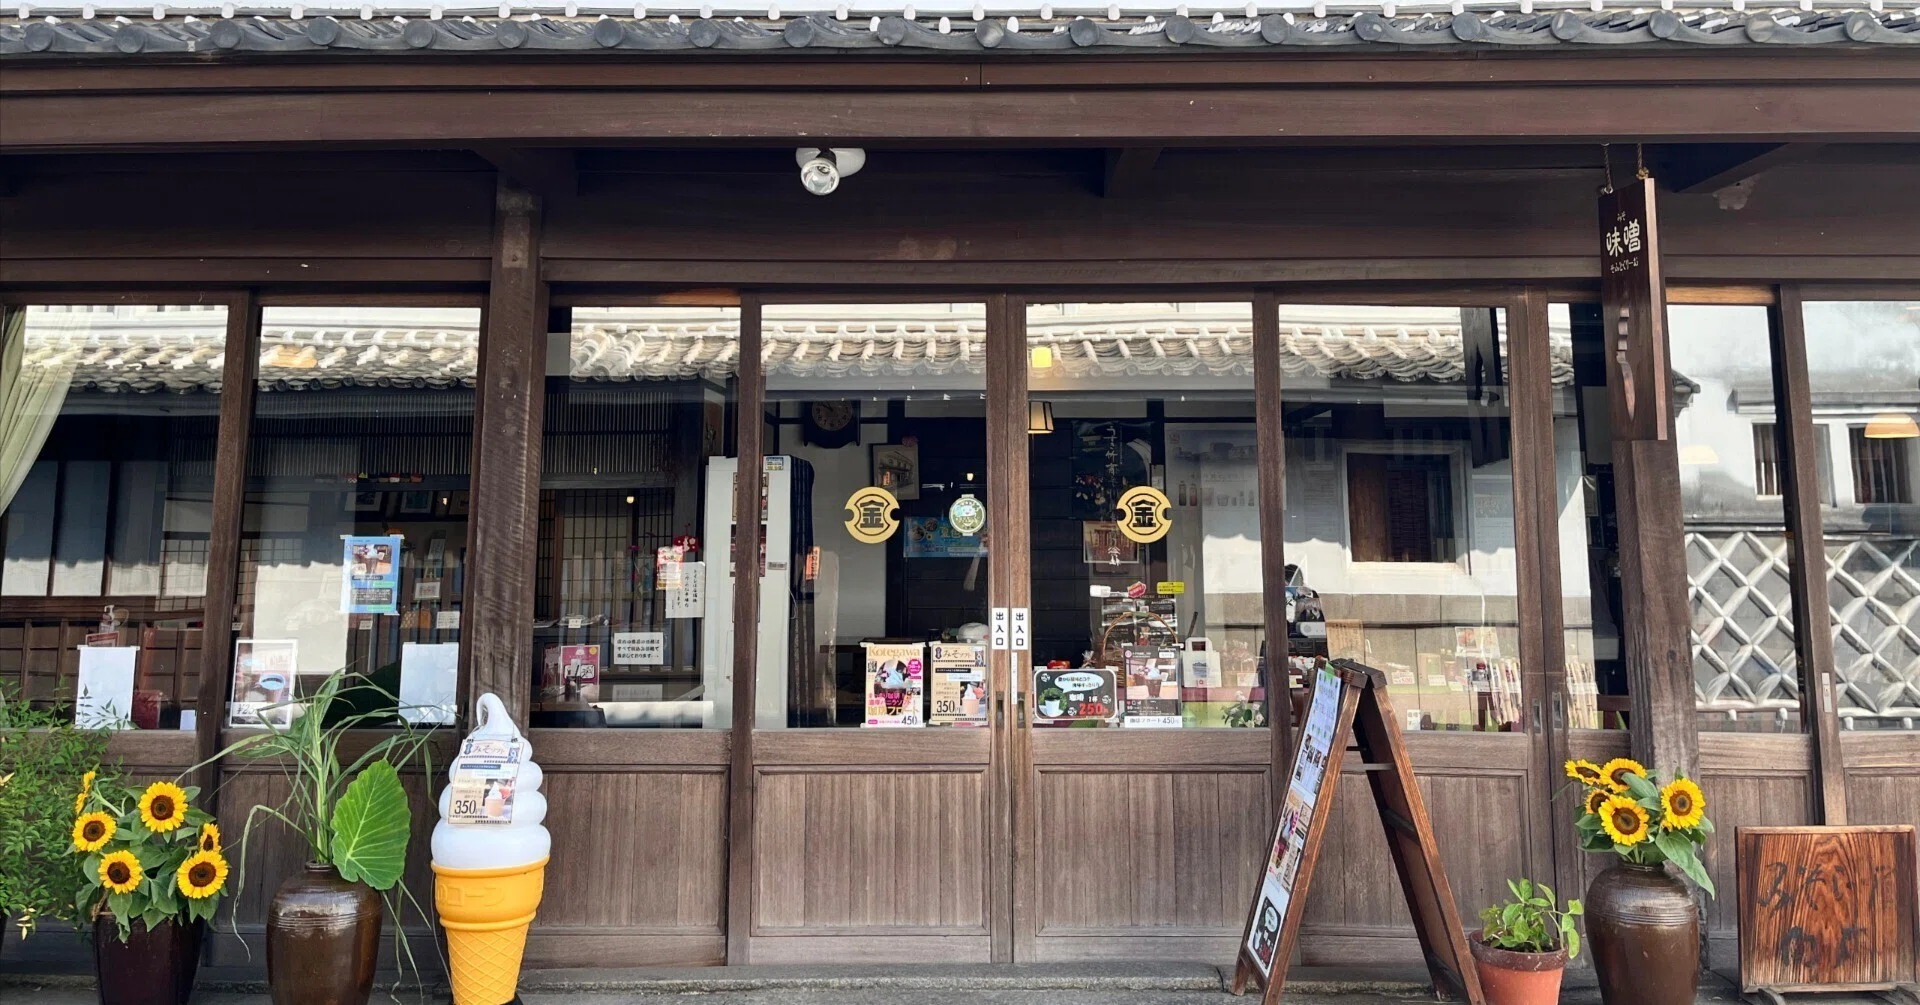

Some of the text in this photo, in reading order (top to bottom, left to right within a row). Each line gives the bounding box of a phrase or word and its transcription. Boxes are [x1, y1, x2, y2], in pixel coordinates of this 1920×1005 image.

[1606, 218, 1641, 257] 味噌
[859, 500, 884, 528] 金
[1131, 499, 1157, 528] 金
[995, 612, 1005, 646] 出入口
[1015, 612, 1025, 647] 出入口
[868, 646, 920, 659] Kotegawa
